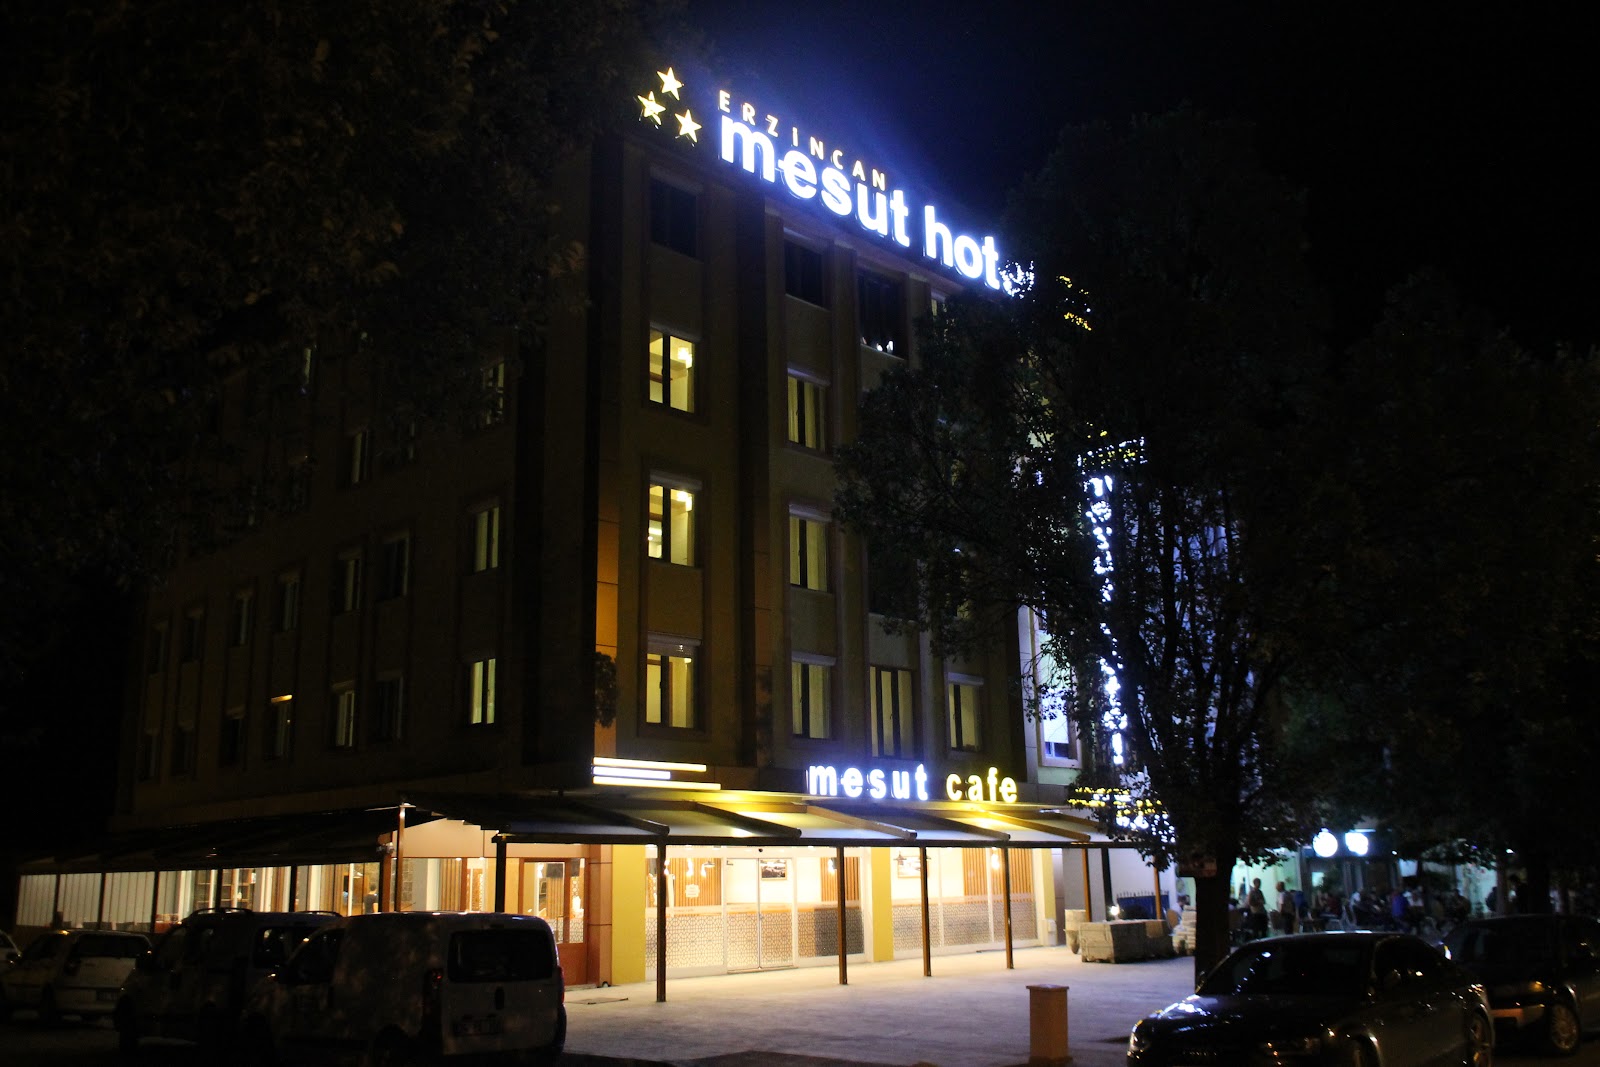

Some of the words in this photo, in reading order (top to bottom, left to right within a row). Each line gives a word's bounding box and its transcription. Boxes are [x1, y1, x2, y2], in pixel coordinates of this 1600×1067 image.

[719, 89, 886, 191] ERZINCAN
[720, 114, 910, 247] mesut
[808, 763, 929, 801] mesut
[945, 766, 1018, 804] cafe
